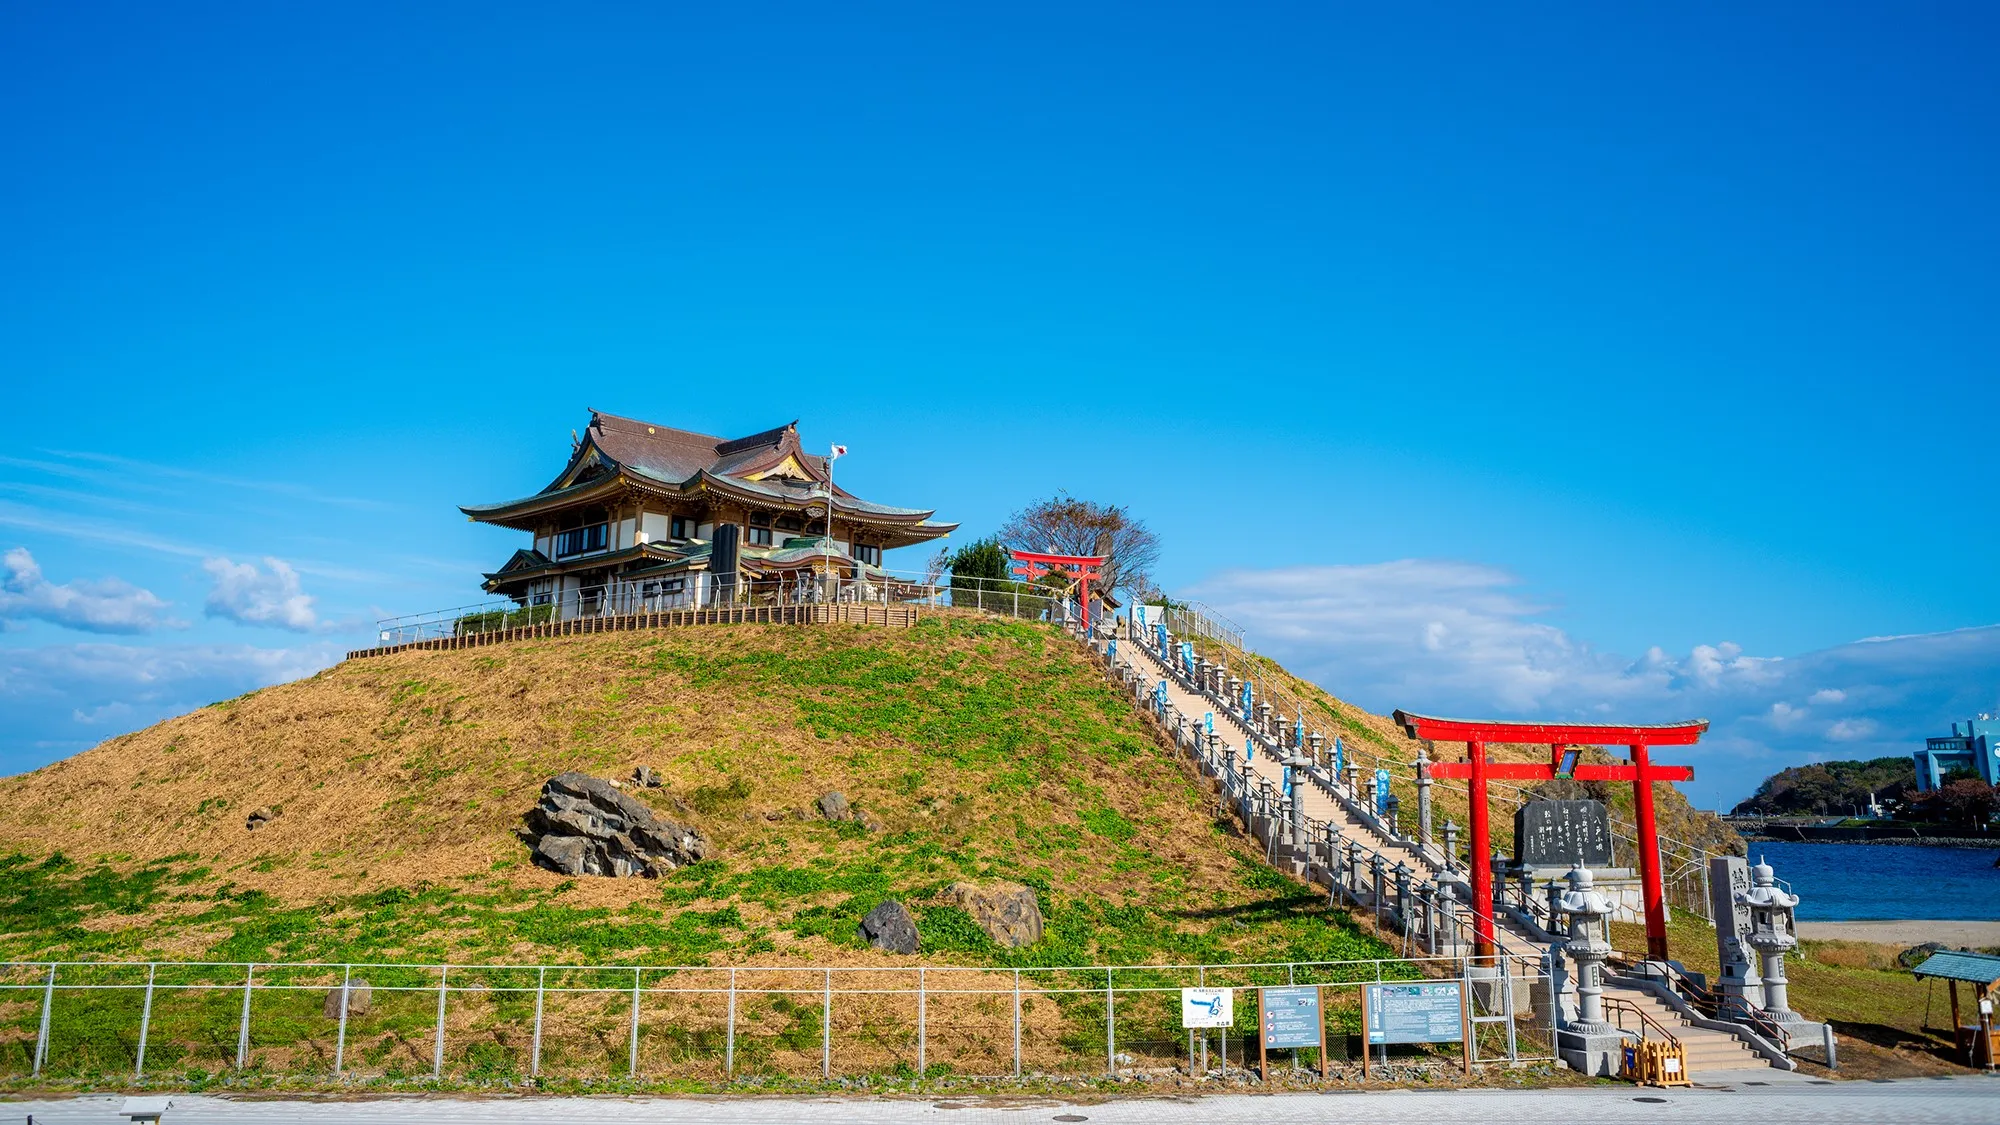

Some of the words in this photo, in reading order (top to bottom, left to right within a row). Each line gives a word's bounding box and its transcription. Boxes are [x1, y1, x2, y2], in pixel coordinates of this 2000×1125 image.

[1594, 816, 1604, 851] 八戸小唄
[1731, 867, 1757, 967] 蕪嶋神
